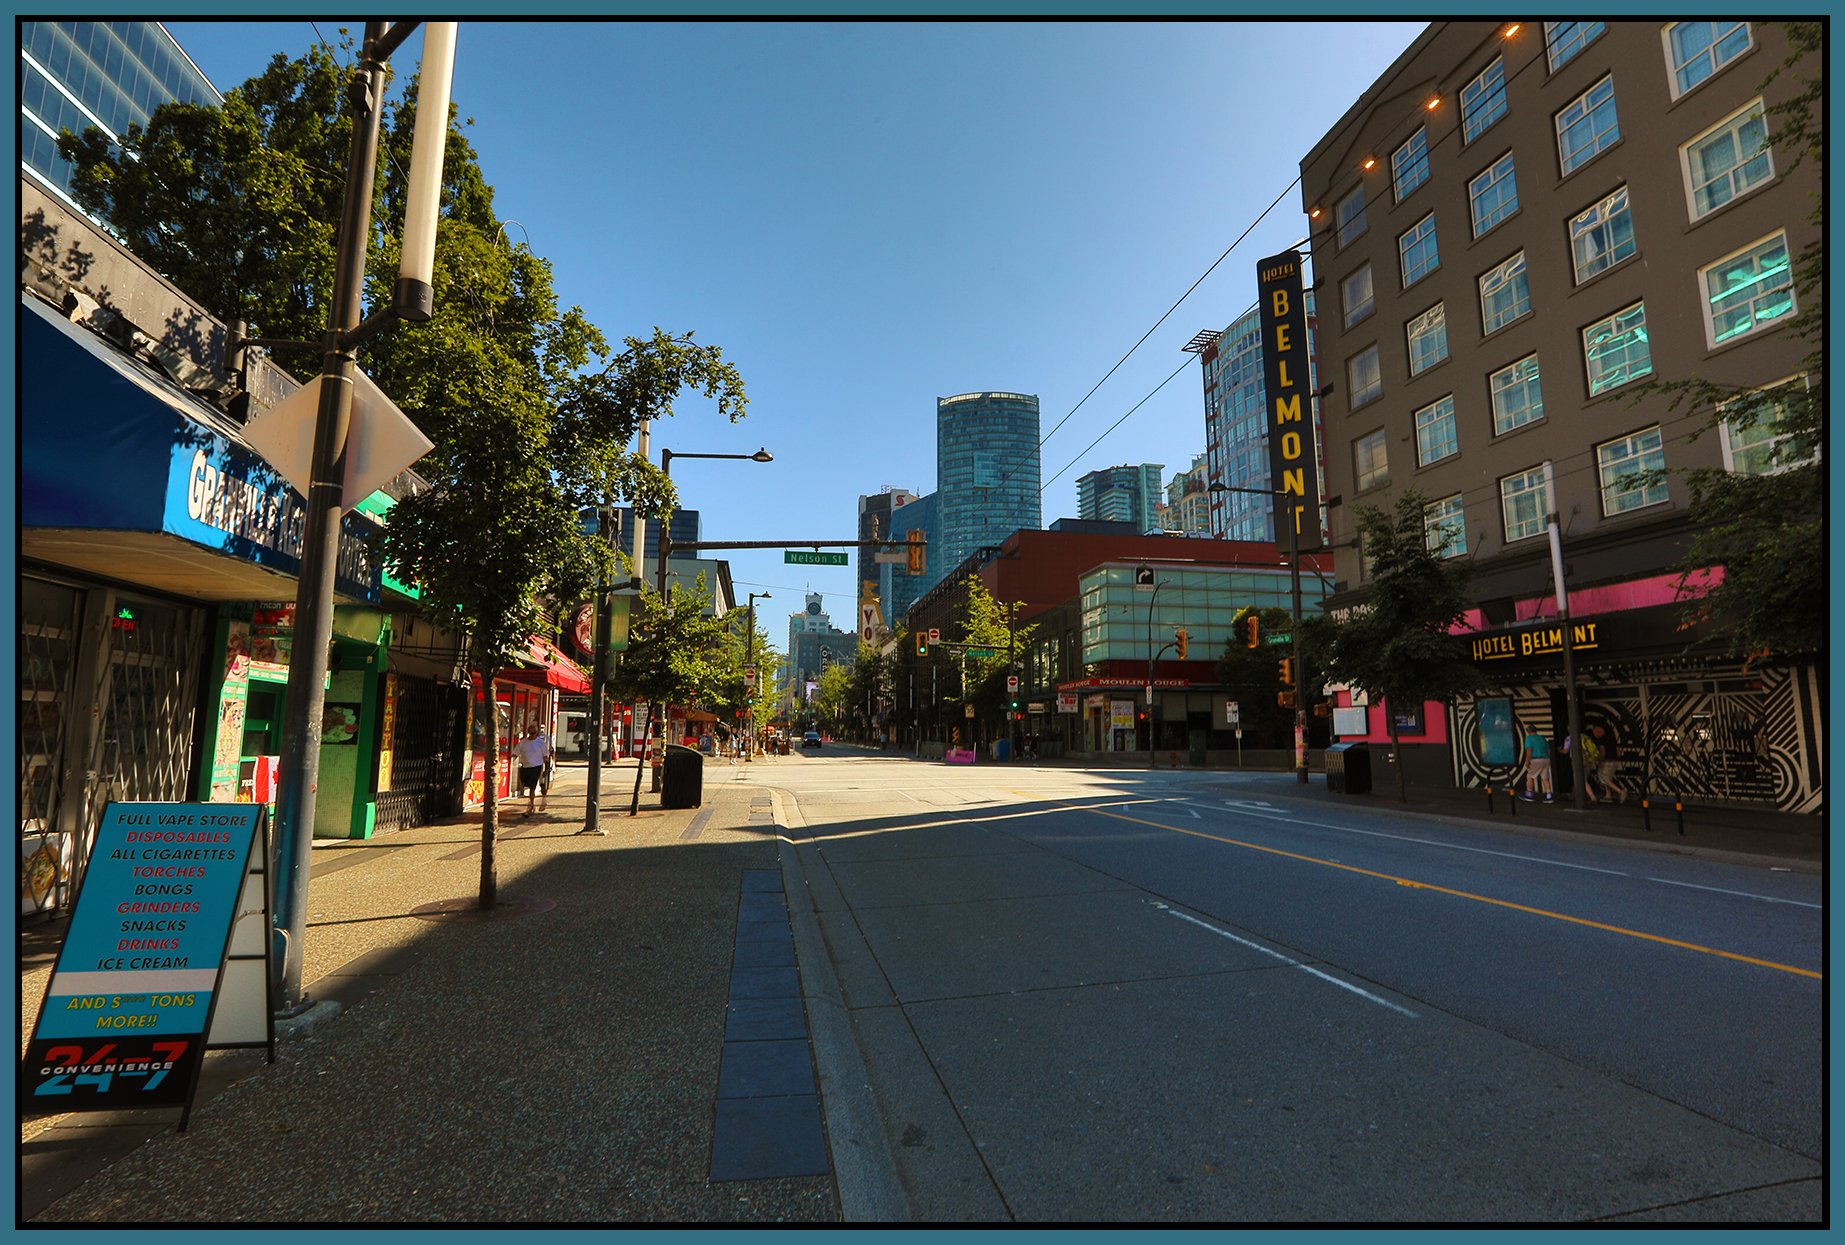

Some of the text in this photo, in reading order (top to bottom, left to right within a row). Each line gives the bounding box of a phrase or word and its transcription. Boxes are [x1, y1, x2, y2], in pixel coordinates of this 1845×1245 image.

[1263, 263, 1294, 284] HOTEL
[1273, 289, 1305, 535] BELMONT
[790, 553, 842, 564] Nelson St
[1472, 623, 1597, 661] HOTEL BELMNT
[380, 678, 396, 784] TATTOO
[118, 814, 249, 827] FULL VAPE STORE
[126, 831, 231, 844] DISPOSABLES
[110, 848, 236, 861] ALL CIGARETTES
[132, 866, 206, 878] TORCHES
[134, 883, 193, 896] BONGS
[117, 901, 200, 914] GRINDERS
[120, 920, 187, 932] SNACKS
[117, 939, 179, 951] DRINKS
[97, 957, 189, 970] ICE CREAM
[67, 997, 106, 1010] AND
[151, 994, 195, 1007] TONS
[96, 1015, 157, 1029] MORE!!
[33, 1040, 189, 1096] 24-7
[40, 1061, 173, 1075] CONVENIENCE
